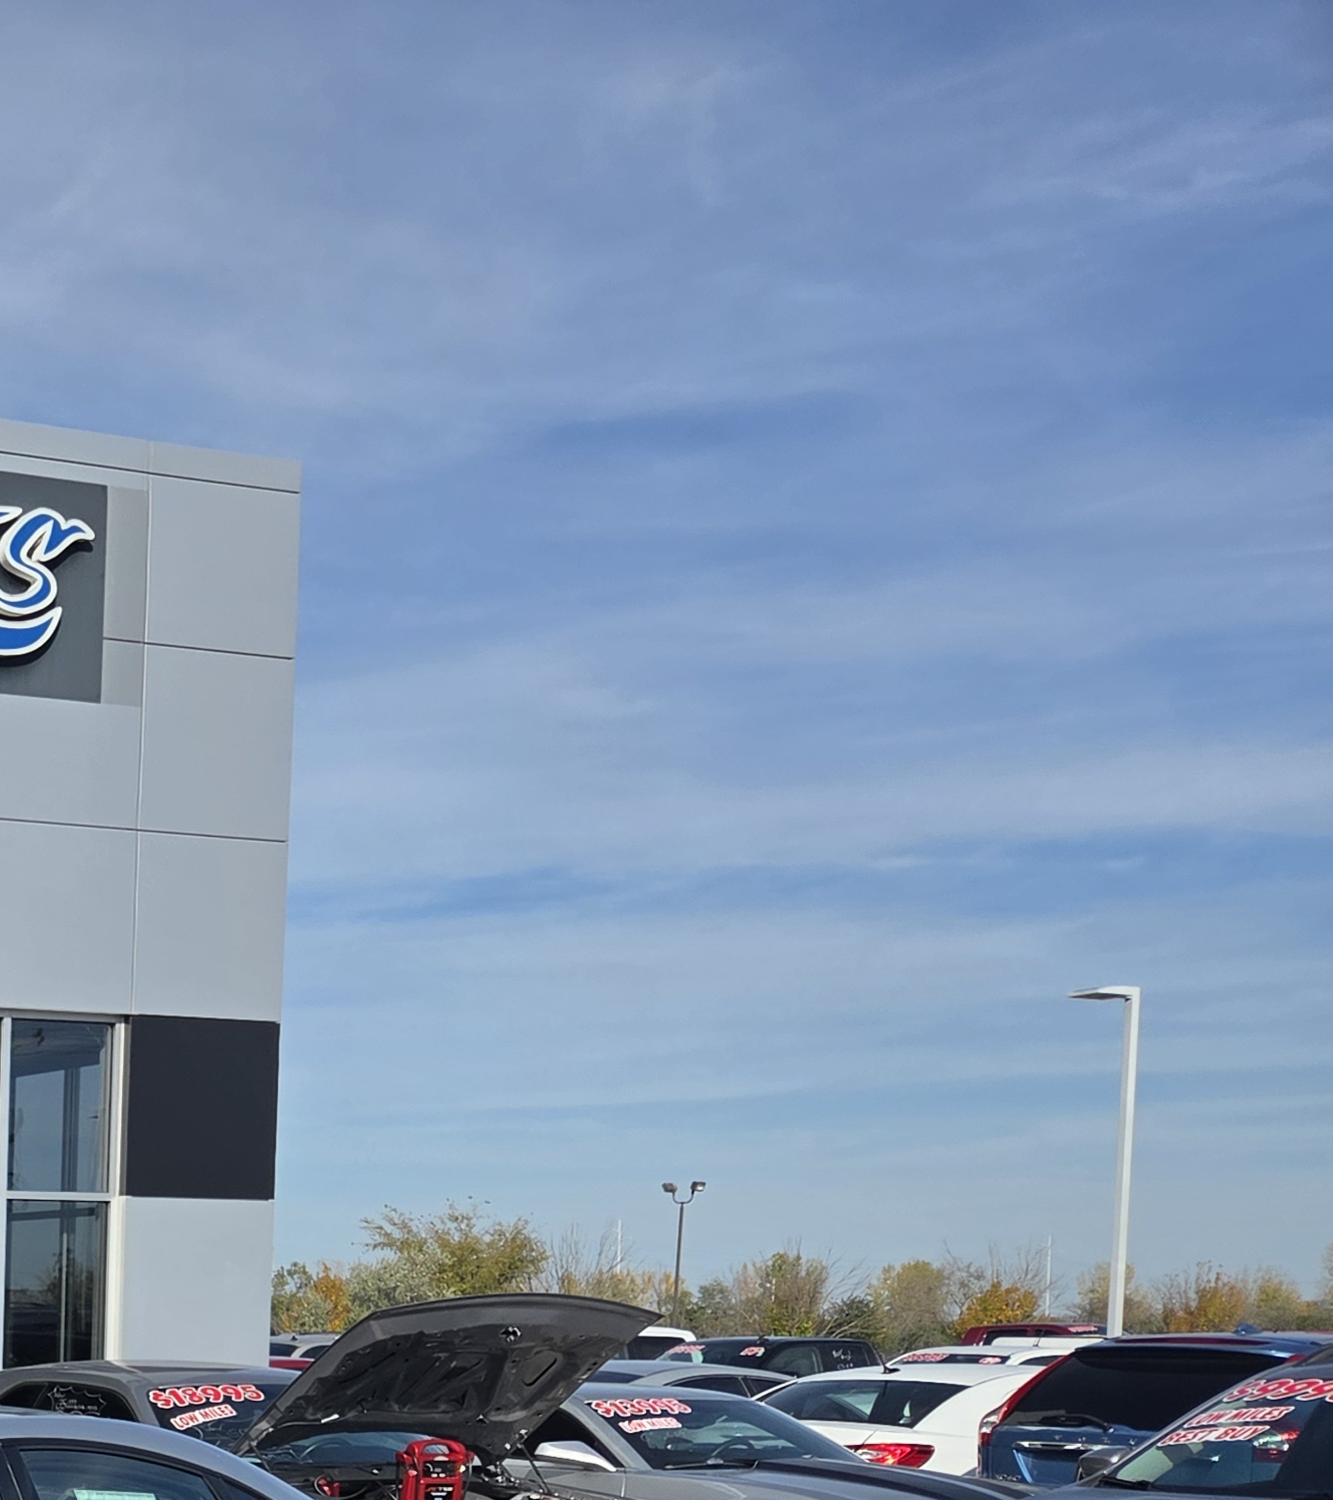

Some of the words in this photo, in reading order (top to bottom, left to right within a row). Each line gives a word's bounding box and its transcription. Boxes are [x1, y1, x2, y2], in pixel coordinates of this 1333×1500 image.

[149, 1384, 265, 1409] $18995
[1223, 1378, 1333, 1403] $999
[170, 1412, 198, 1431] LOW
[199, 1404, 238, 1425] MILES
[1184, 1410, 1228, 1428] LOW
[1226, 1406, 1295, 1422] MILES
[1157, 1427, 1218, 1446] BEST
[1215, 1425, 1270, 1442] BUY
